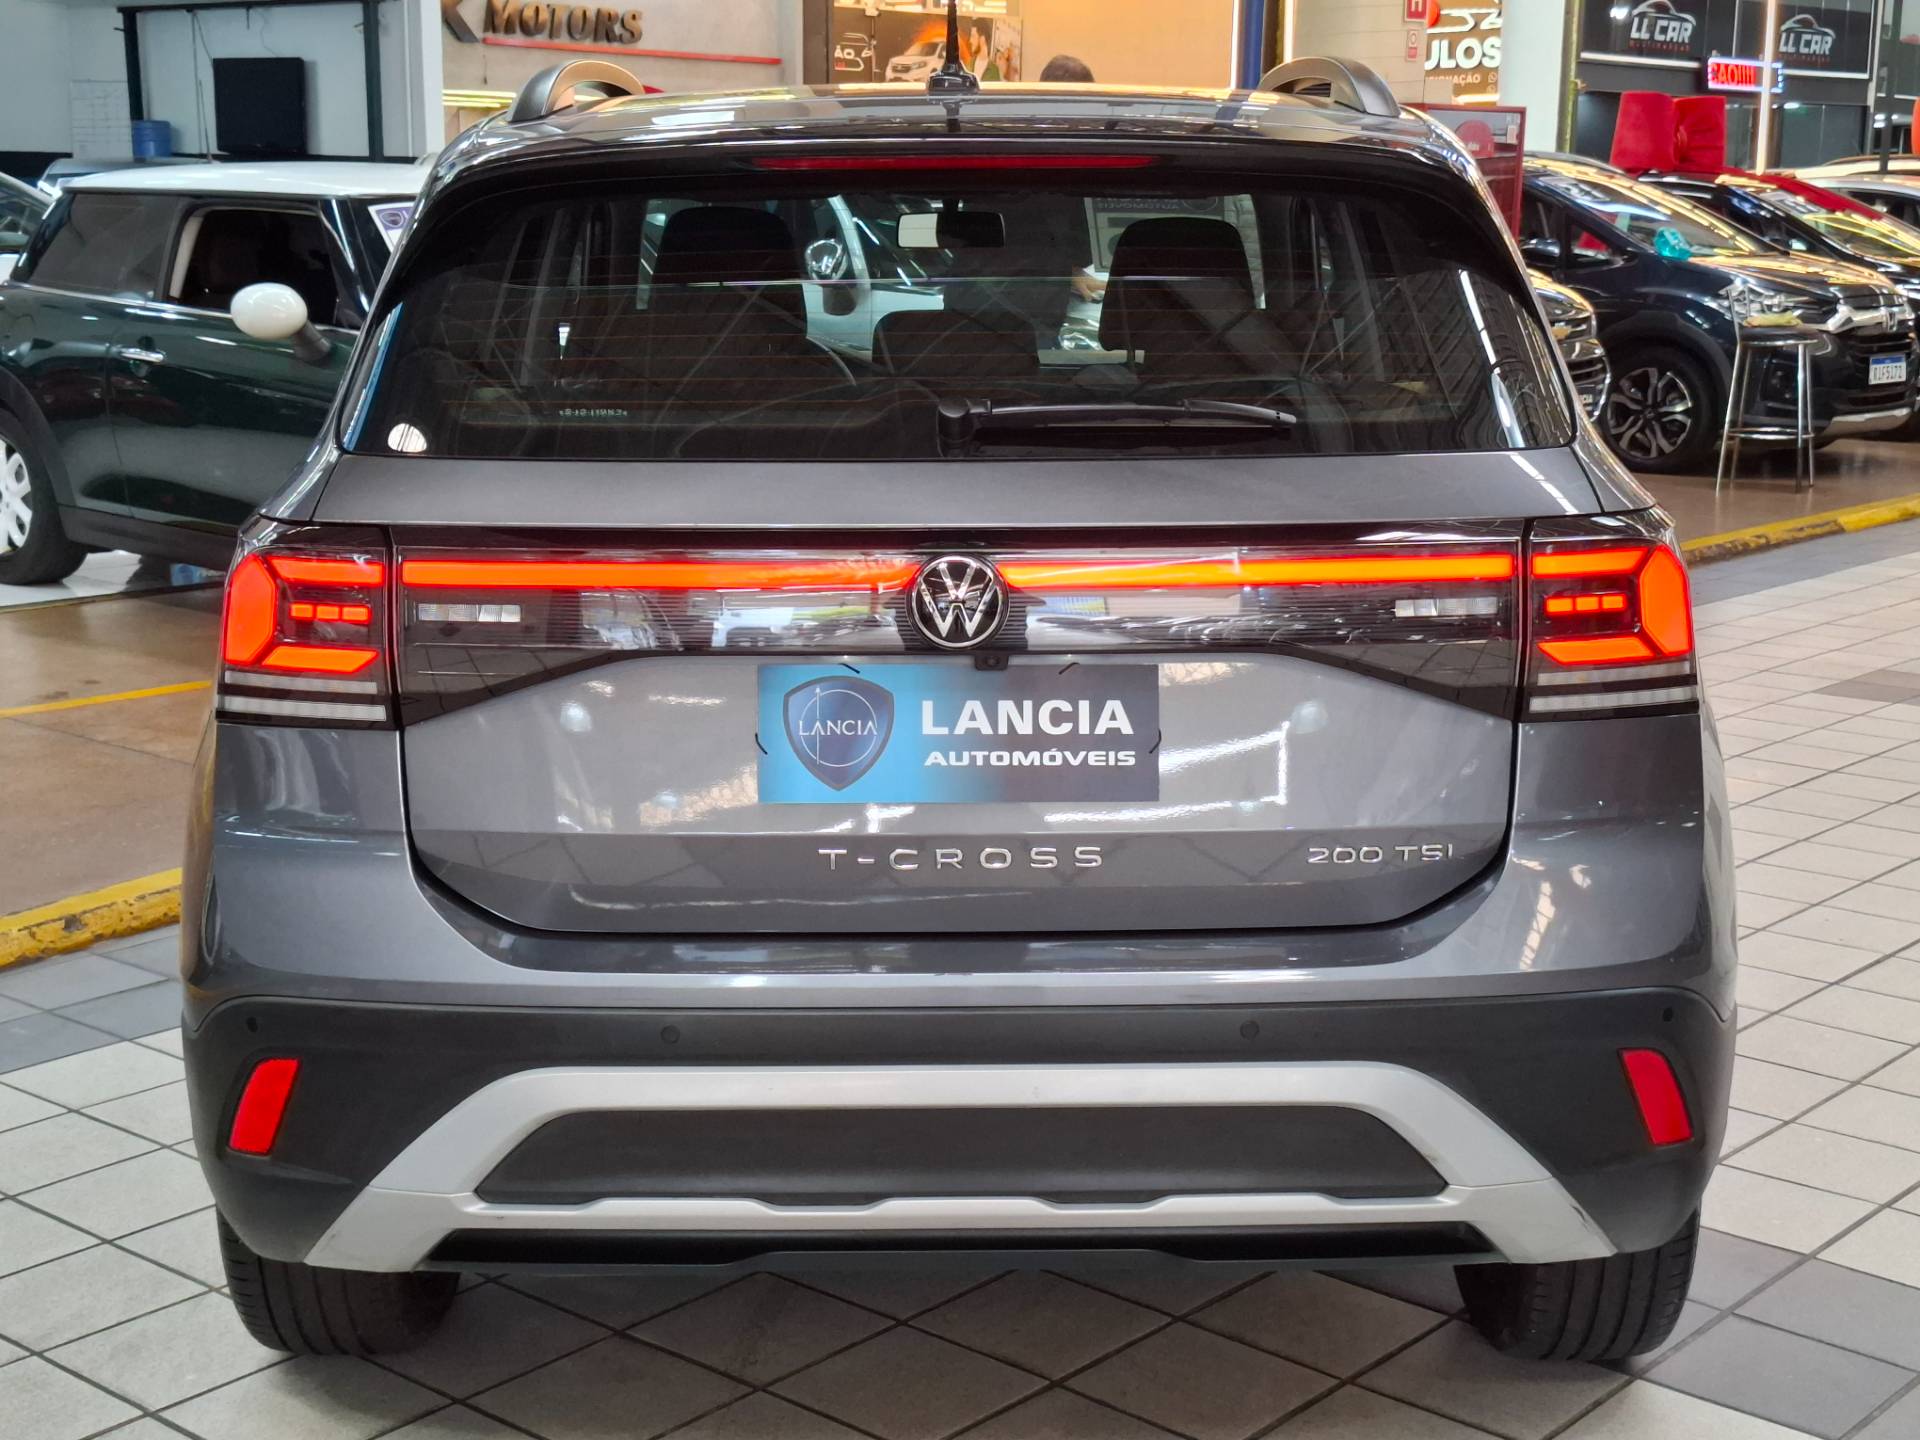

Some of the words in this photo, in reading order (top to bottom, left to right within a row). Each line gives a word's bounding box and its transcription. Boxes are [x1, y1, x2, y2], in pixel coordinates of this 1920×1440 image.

[483, 0, 644, 44] MOTORS
[1630, 16, 1651, 40] LL
[1653, 19, 1693, 44] CAR
[1779, 32, 1797, 53] LL
[1799, 33, 1833, 55] CAR
[798, 719, 878, 736] LANCIA
[921, 699, 1134, 736] LANCIA
[924, 747, 1136, 766] AUTOMÓVEIS
[817, 846, 1104, 871] T-CROSS
[1307, 846, 1384, 864] 200
[1394, 843, 1454, 862] TSI
